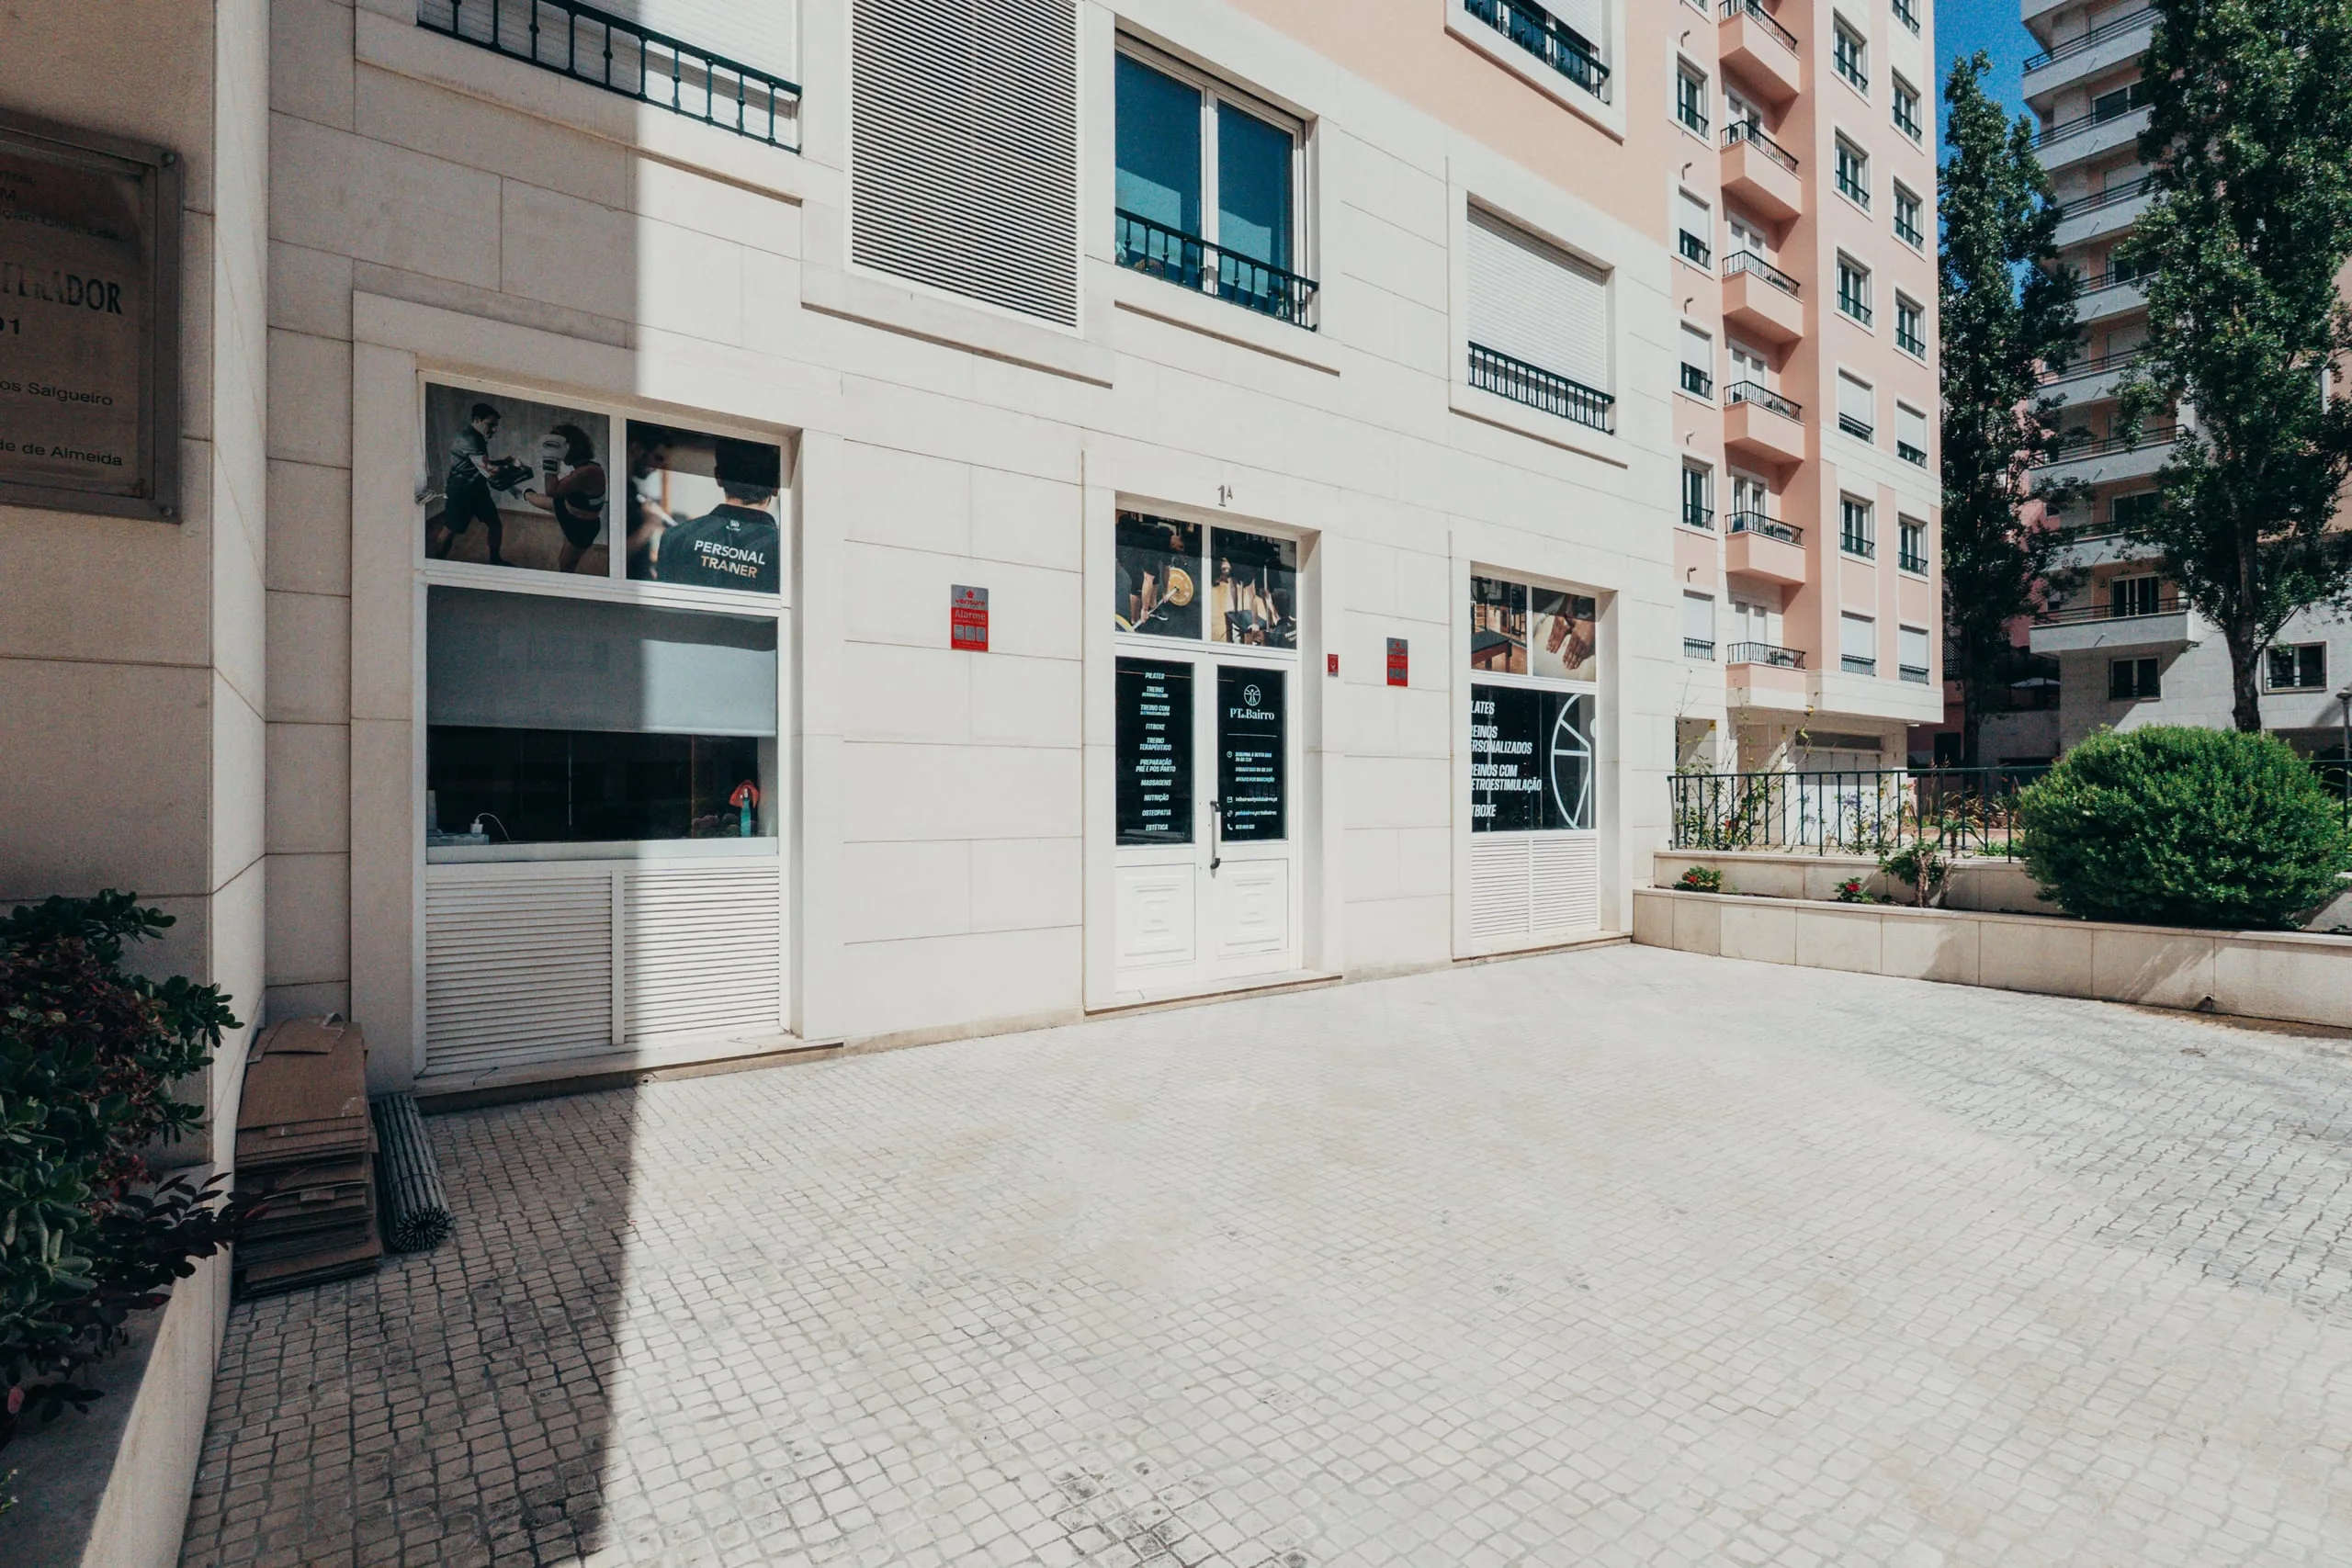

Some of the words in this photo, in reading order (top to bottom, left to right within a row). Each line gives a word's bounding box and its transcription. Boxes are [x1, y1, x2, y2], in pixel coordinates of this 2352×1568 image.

[27, 382, 113, 406] Salgueiro
[21, 443, 46, 457] de
[51, 446, 123, 466] Almeida
[694, 540, 765, 565] PERSONAL
[700, 556, 758, 579] TRAINER
[1498, 764, 1518, 778] COM
